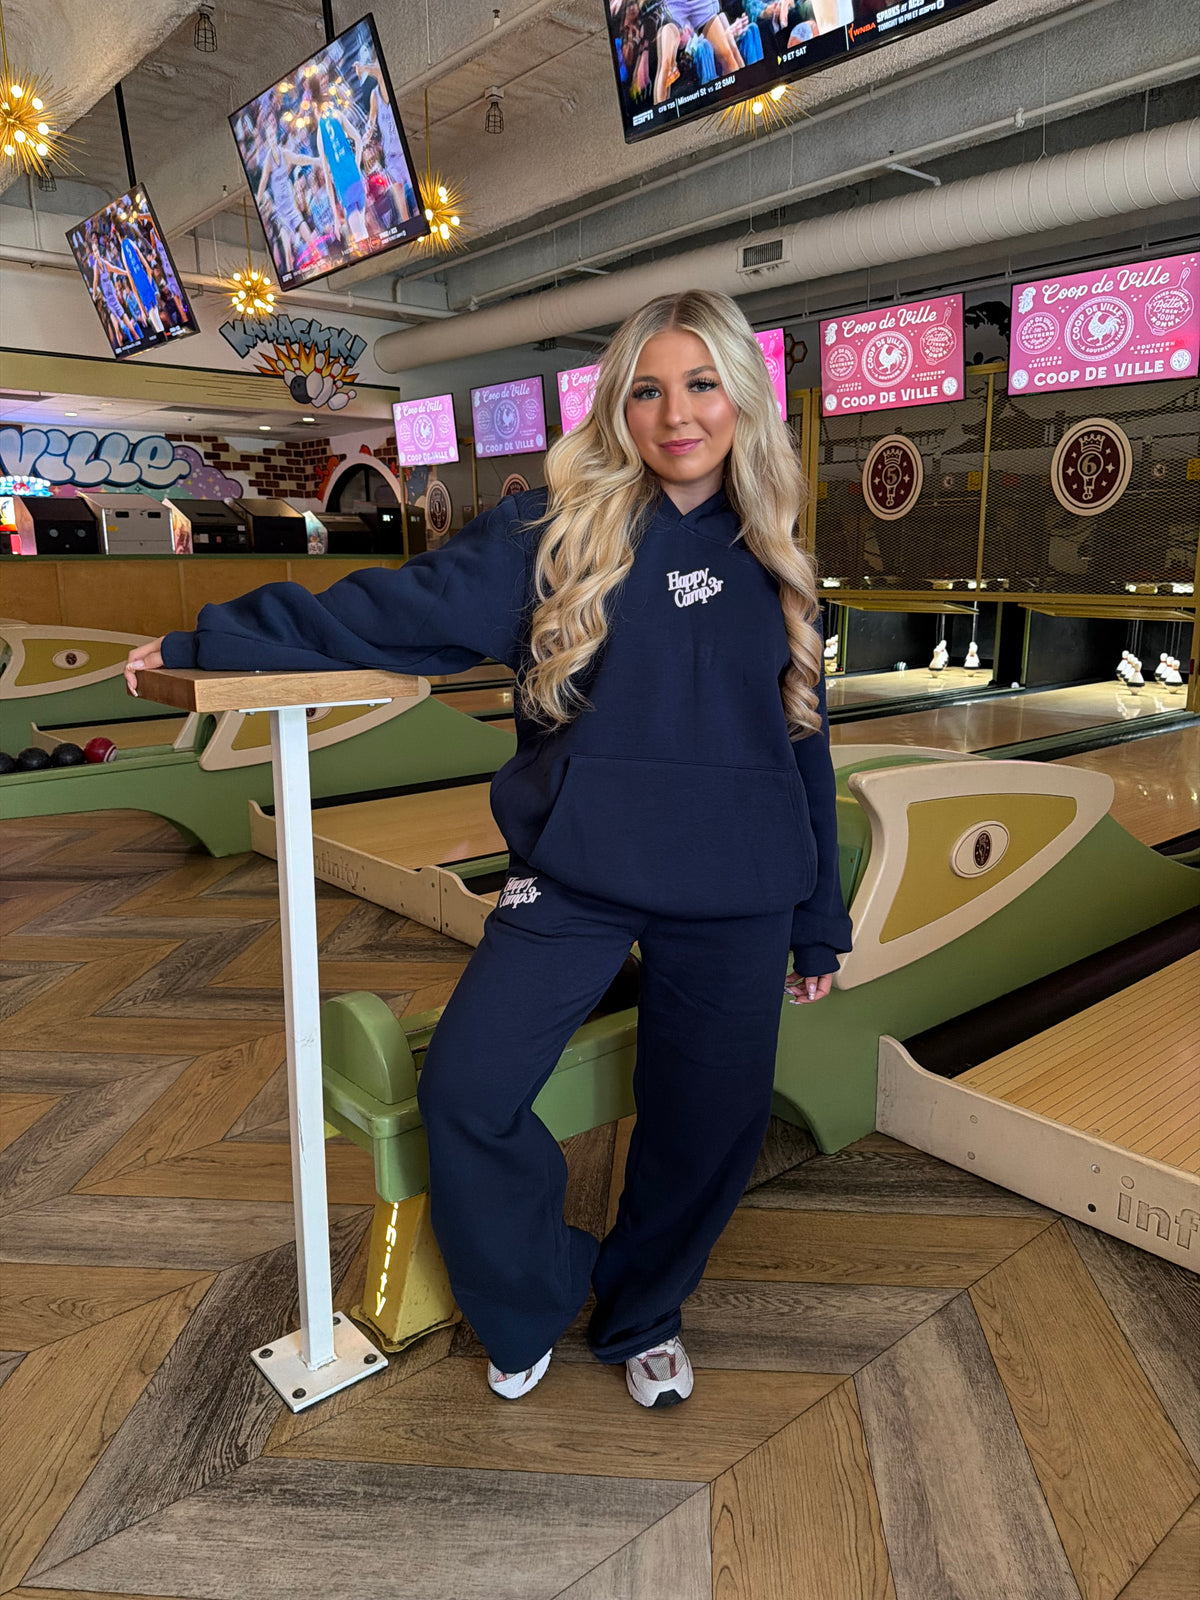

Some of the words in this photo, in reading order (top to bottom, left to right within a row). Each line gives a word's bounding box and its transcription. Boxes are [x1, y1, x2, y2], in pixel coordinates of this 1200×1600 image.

[876, 4, 900, 23] SPARKS
[853, 22, 876, 37] WNBA
[787, 52, 795, 60] ET
[795, 45, 807, 58] SAT
[677, 89, 700, 106] Missouri
[700, 87, 707, 96] St
[714, 82, 722, 91] 22
[722, 75, 736, 90] SMU
[633, 109, 654, 126] ESPN
[1042, 283, 1088, 305] Coop
[1091, 274, 1114, 293] de
[1116, 265, 1170, 291] Ville
[842, 319, 876, 338] Coop
[879, 312, 896, 329] de
[897, 305, 937, 327] Ville
[1072, 313, 1084, 340] COOP
[1085, 304, 1098, 316] DE
[1100, 302, 1123, 317] VILLE
[867, 346, 875, 369] COOP
[875, 339, 885, 347] DE
[886, 336, 904, 349] VILLE
[1137, 341, 1176, 350] SOUTHERN
[571, 372, 592, 386] Coop
[1034, 370, 1080, 387] COOP
[1085, 366, 1107, 381] DE
[1113, 360, 1164, 378] VILLE
[482, 390, 500, 403] Coop
[501, 386, 509, 398] de
[510, 383, 530, 397] Ville
[841, 394, 876, 409] COOP
[879, 391, 896, 404] DE
[901, 386, 939, 401] VILLE
[425, 400, 442, 412] Ville
[485, 443, 503, 453] COOP
[504, 442, 513, 451] DE
[515, 439, 534, 450] VILLE
[406, 453, 422, 462] COOP
[1081, 454, 1097, 475] 6
[887, 467, 898, 485] 5
[666, 567, 710, 593] Happy
[674, 576, 724, 608] Camp3r
[314, 850, 359, 890] nfinity
[504, 876, 538, 894] Happy
